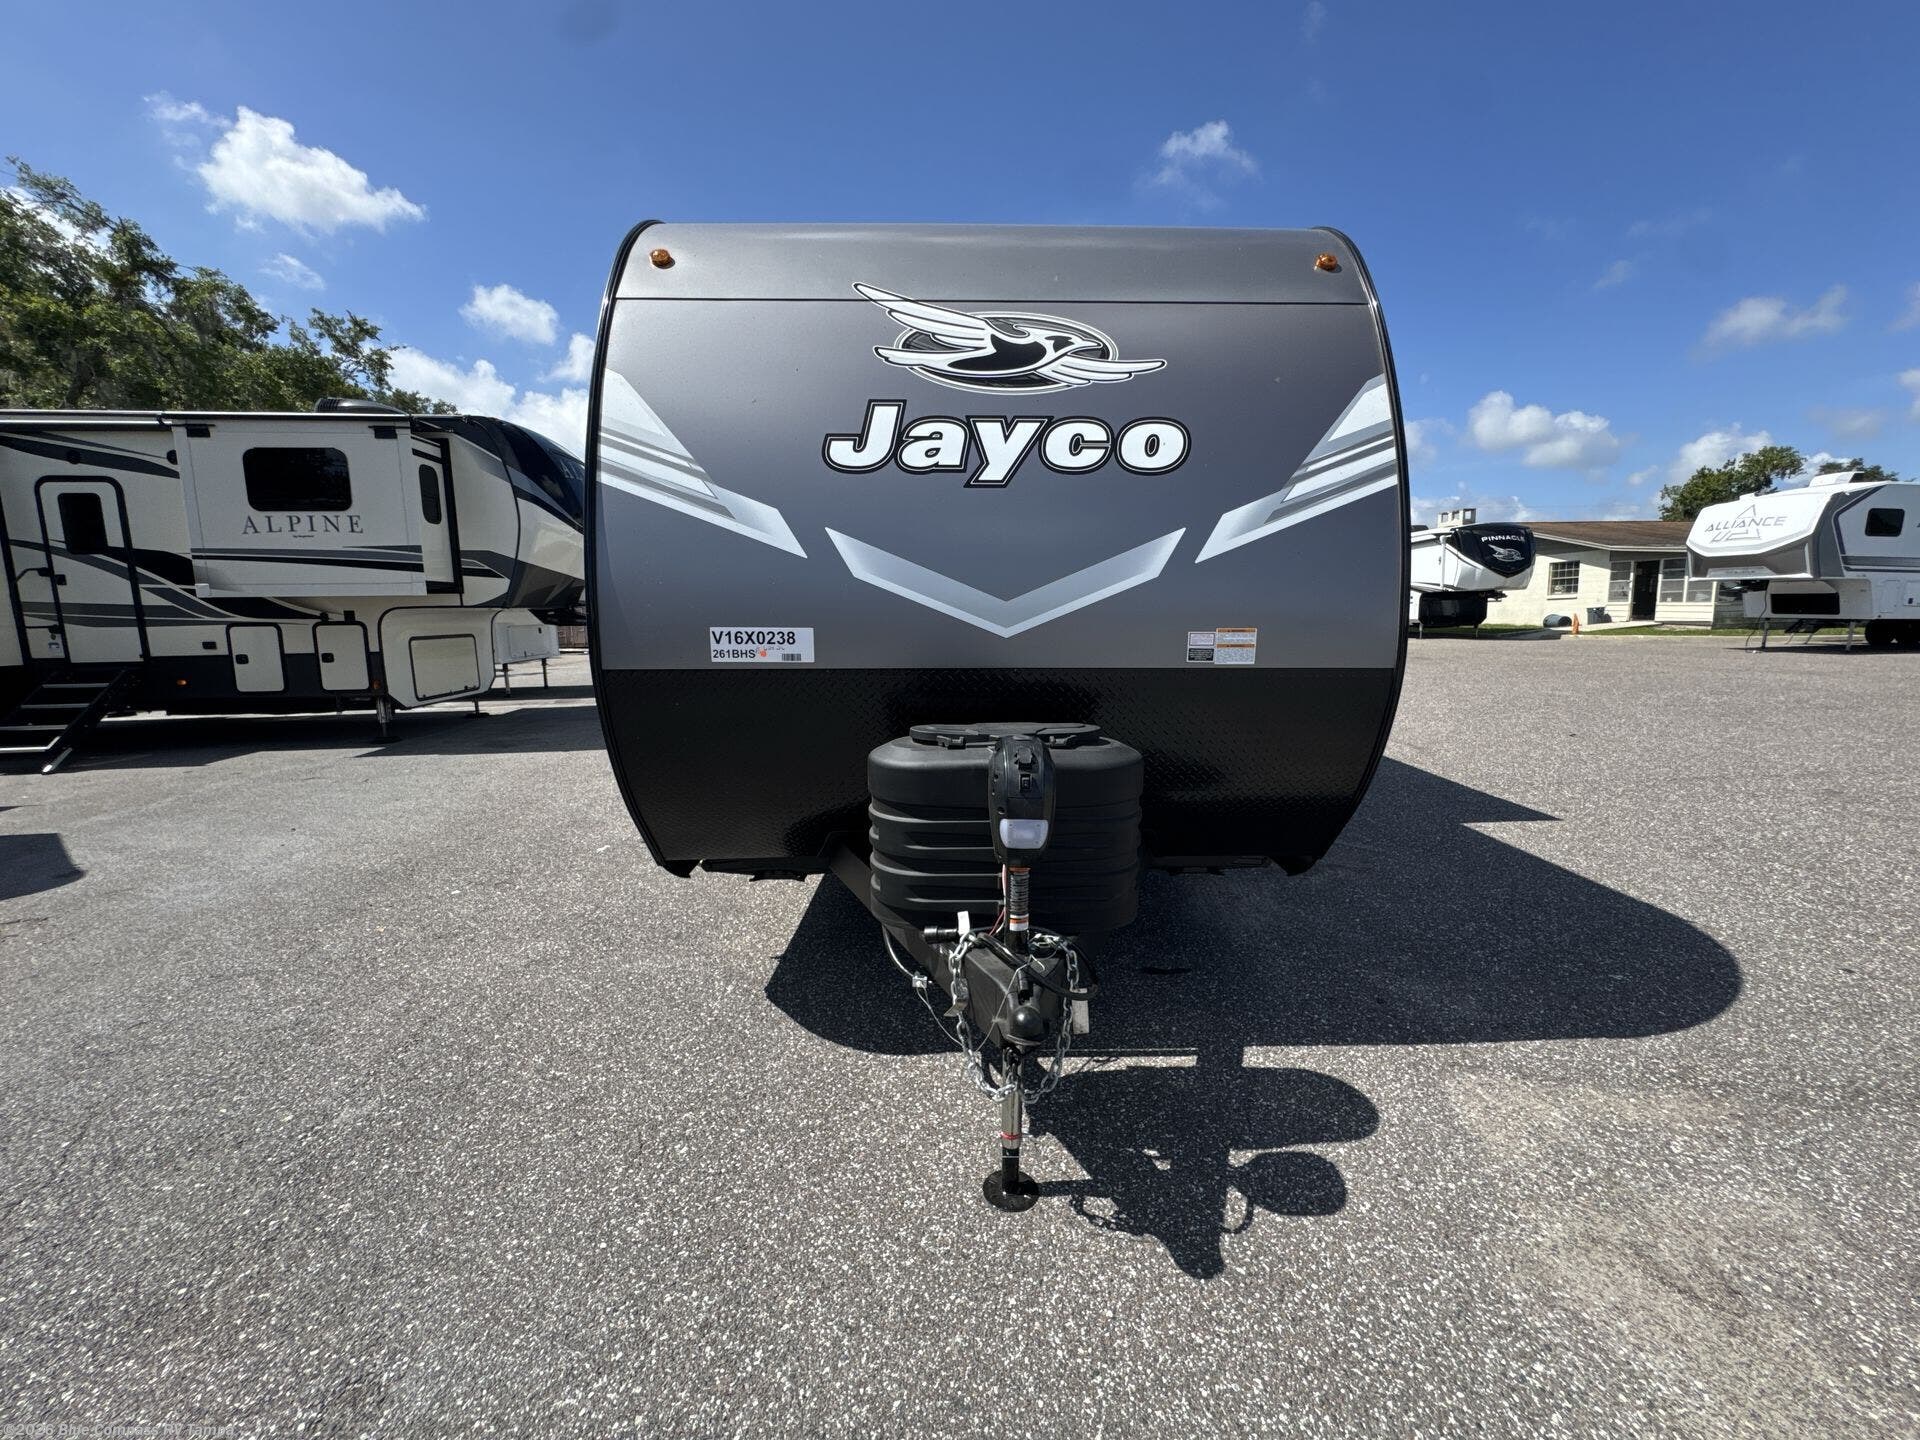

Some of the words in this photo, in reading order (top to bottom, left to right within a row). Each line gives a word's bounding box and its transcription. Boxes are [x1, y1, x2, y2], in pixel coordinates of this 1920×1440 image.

[822, 399, 1192, 488] Jayco
[242, 514, 364, 535] ALPINE
[1704, 516, 1787, 532] ALLIANCE
[711, 630, 796, 645] V16X0238
[712, 649, 756, 659] 261BHS
